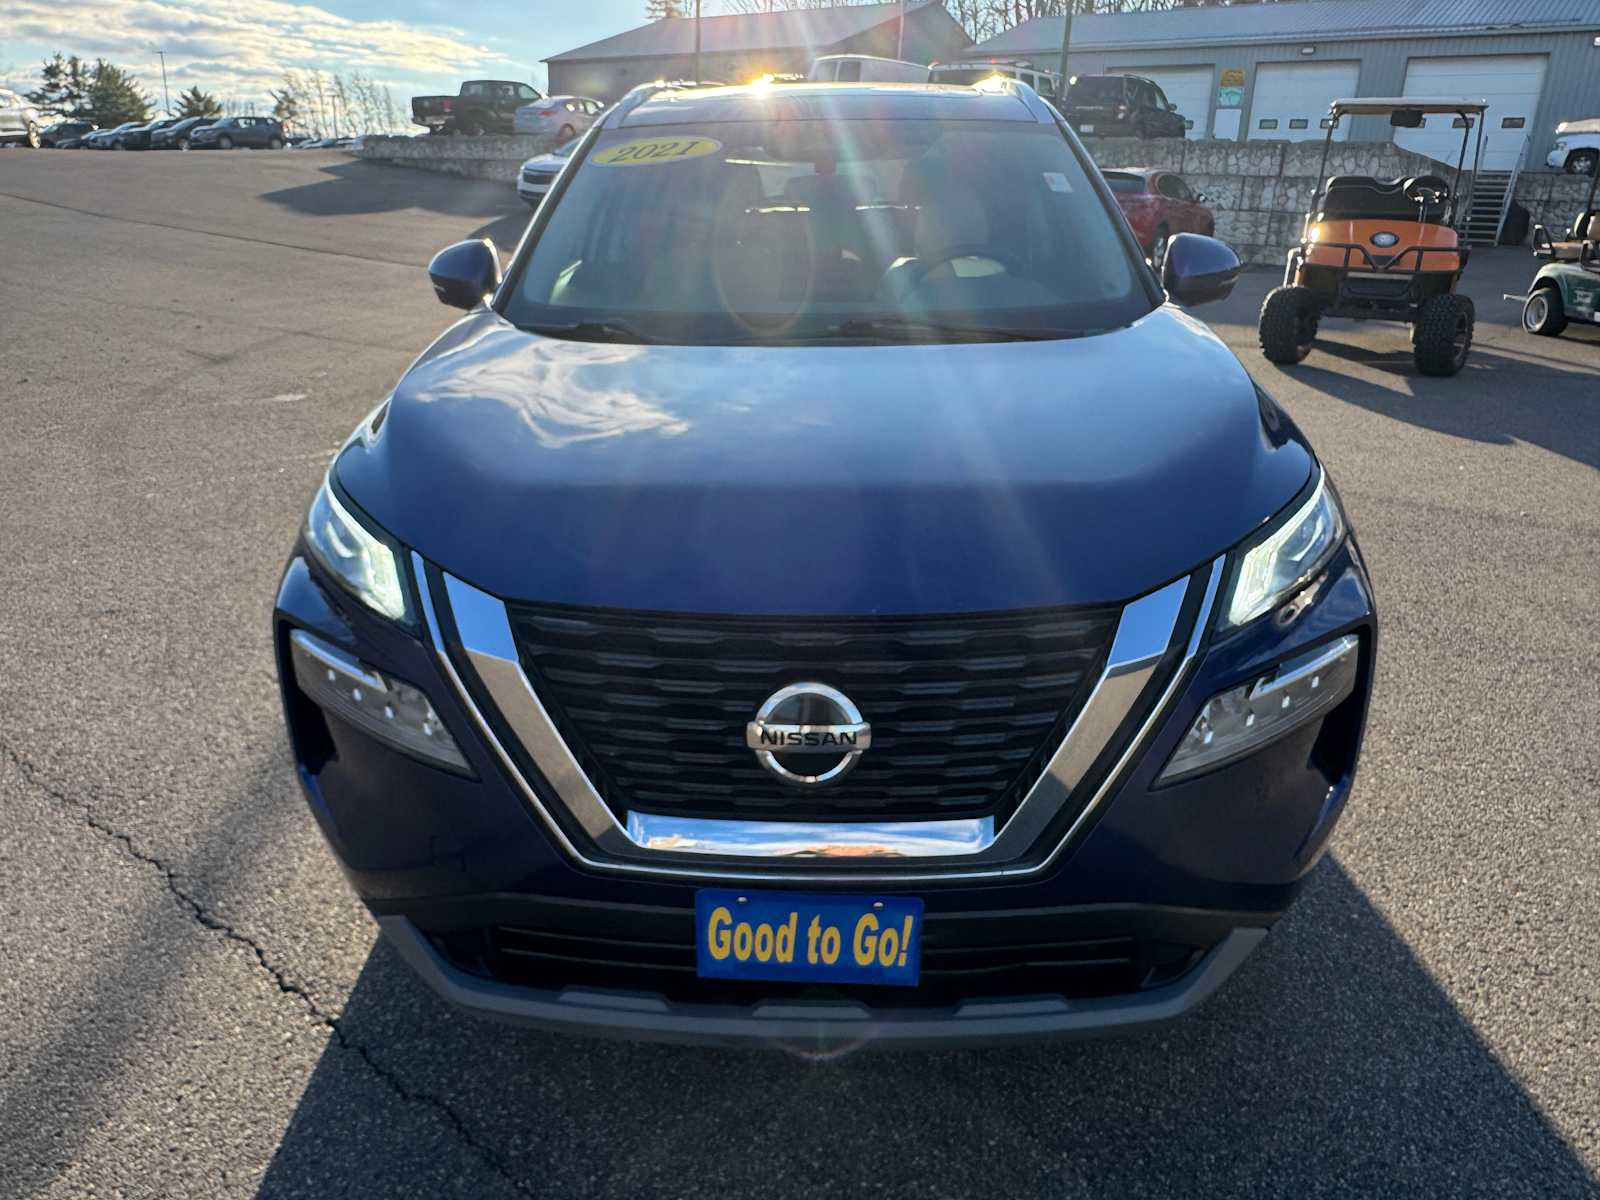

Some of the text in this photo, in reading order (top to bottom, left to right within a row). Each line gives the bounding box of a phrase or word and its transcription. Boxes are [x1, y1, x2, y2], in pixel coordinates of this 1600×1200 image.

[607, 140, 699, 164] 2021
[760, 730, 858, 746] NISSAN
[708, 906, 914, 967] Good to Go!
